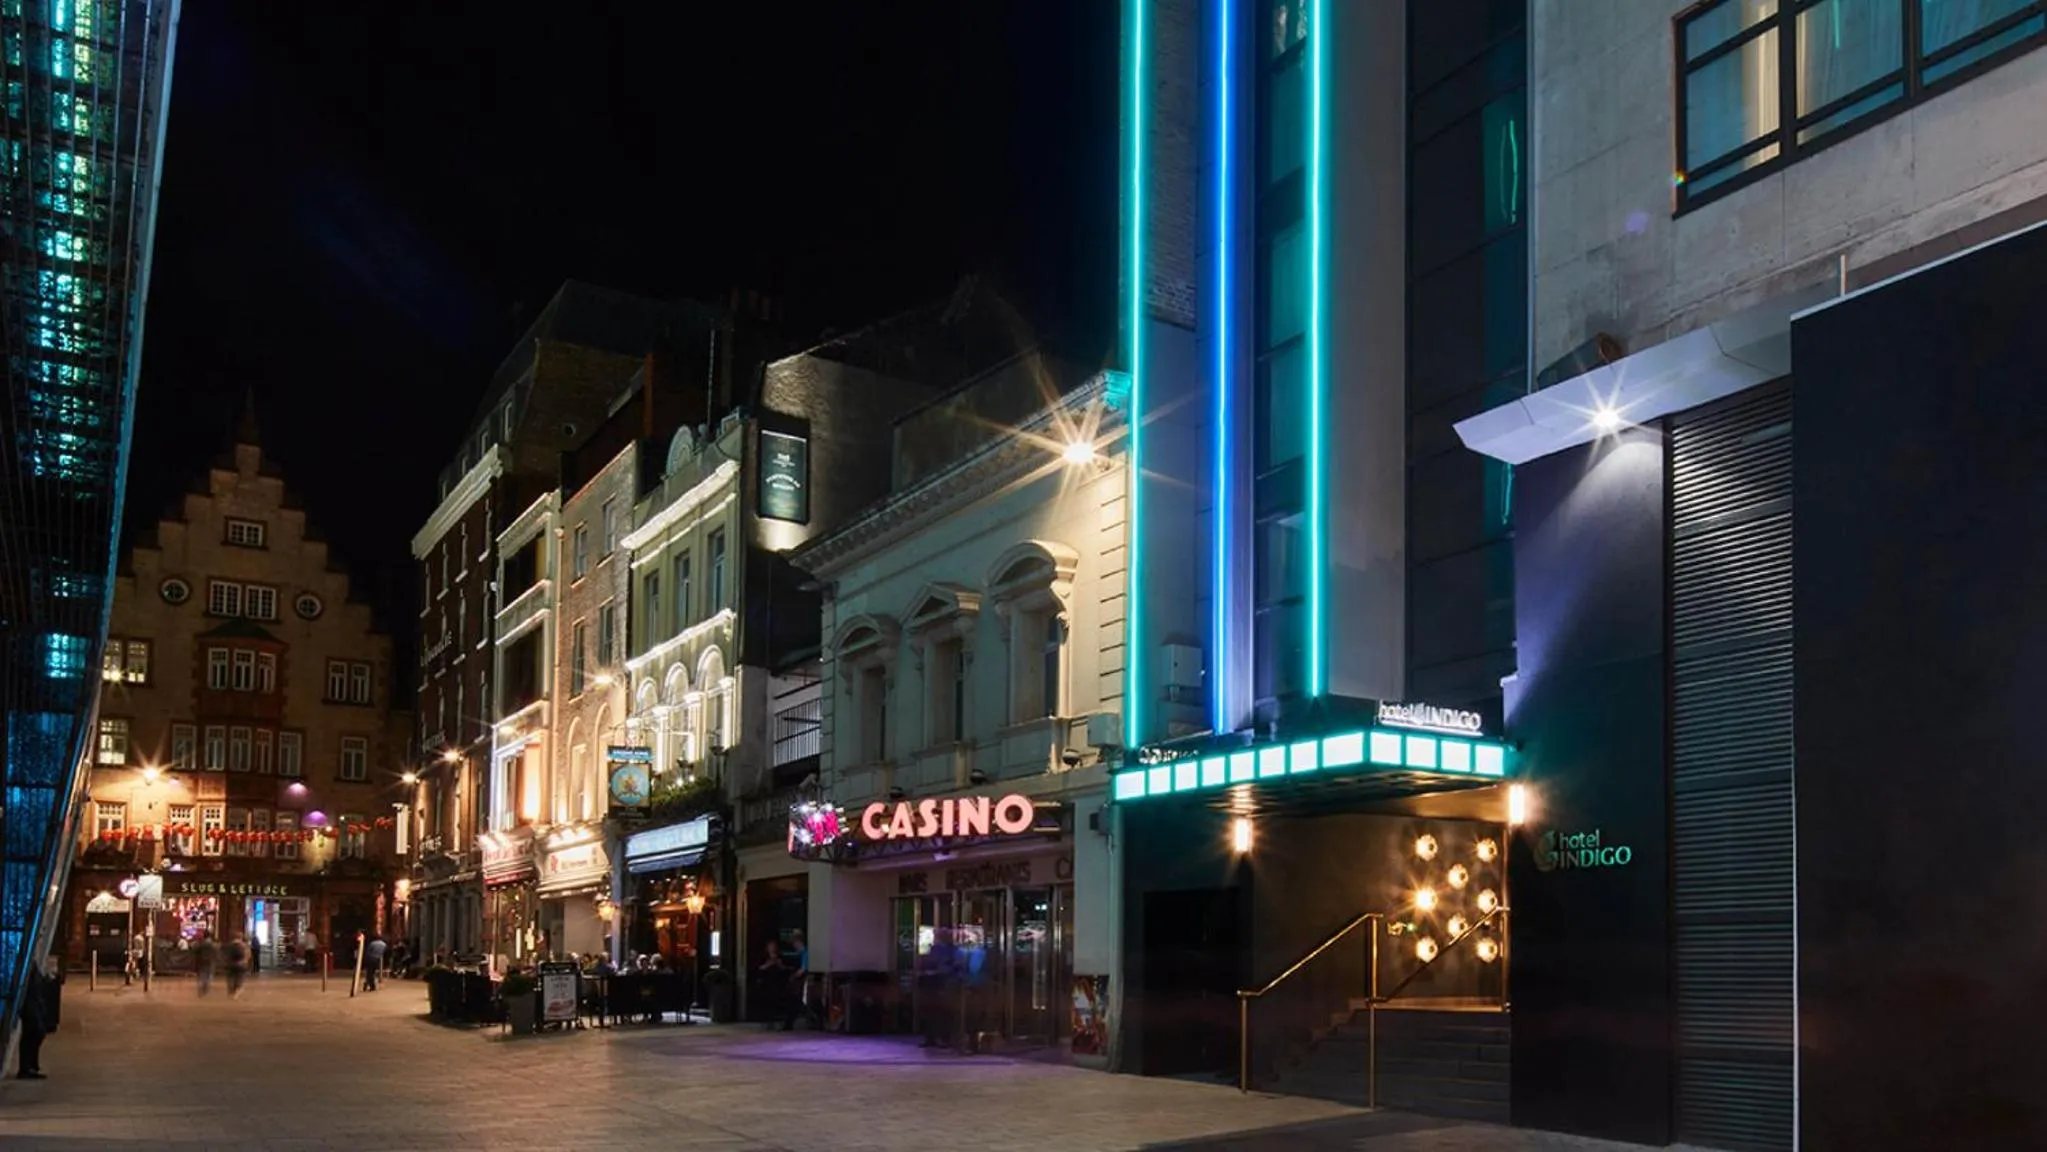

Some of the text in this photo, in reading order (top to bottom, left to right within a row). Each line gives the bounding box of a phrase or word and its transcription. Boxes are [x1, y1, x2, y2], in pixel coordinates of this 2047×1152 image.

[1424, 705, 1482, 731] INDIGO
[861, 794, 1034, 841] CASINO
[1559, 828, 1600, 849] hotel
[1560, 846, 1632, 869] INDIGO
[181, 882, 215, 893] SLUG
